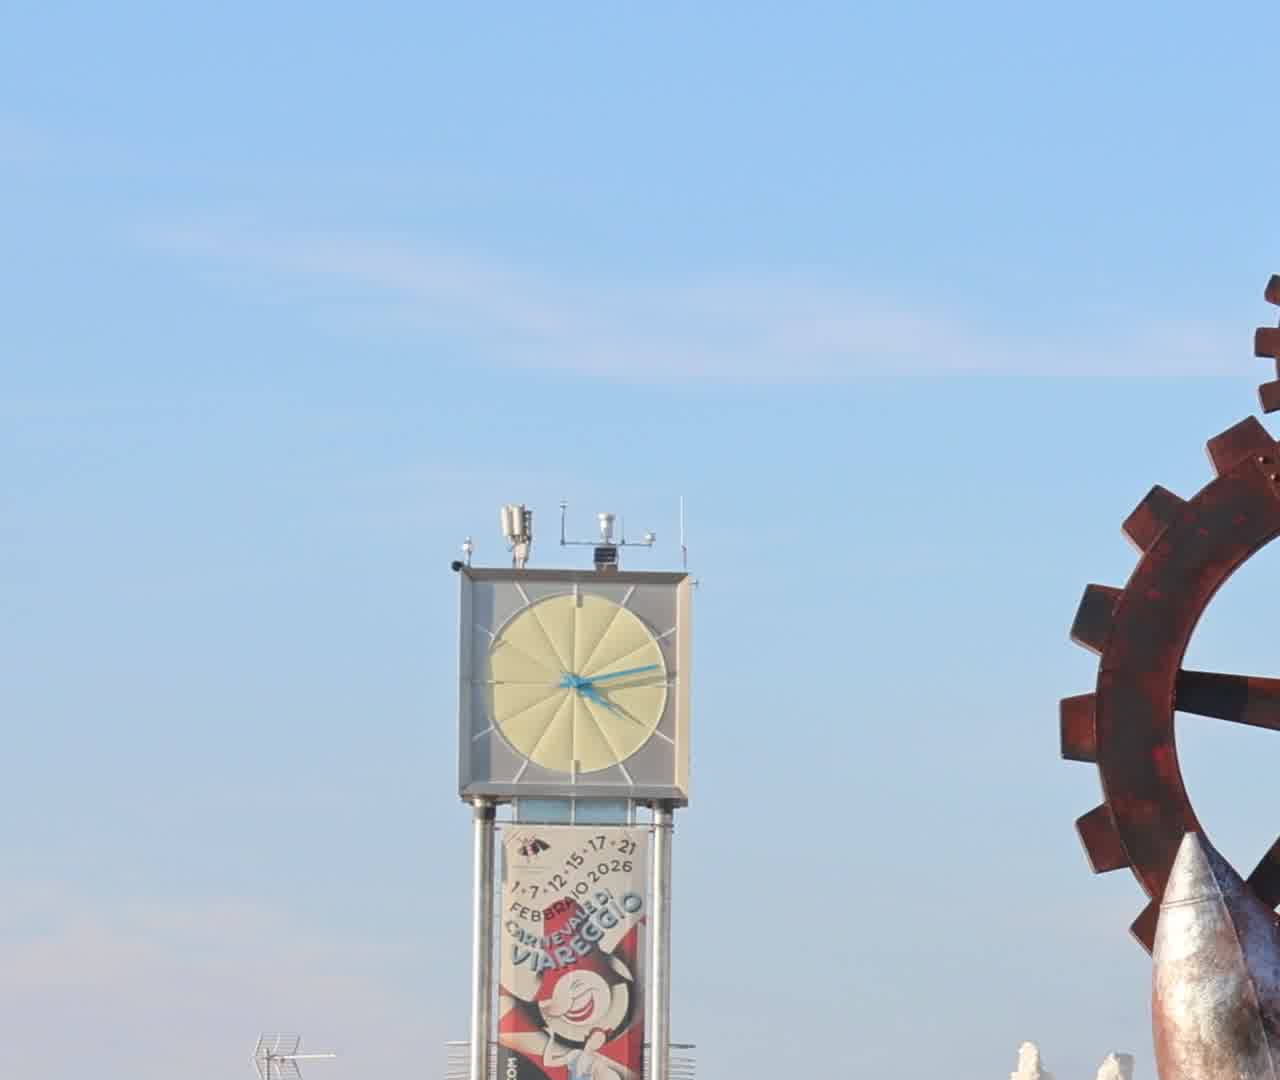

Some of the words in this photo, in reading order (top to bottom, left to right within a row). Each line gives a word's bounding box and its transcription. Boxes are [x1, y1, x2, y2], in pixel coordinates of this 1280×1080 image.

[510, 881, 589, 922] FEBBRAIO
[587, 860, 633, 883] 2026
[529, 885, 540, 899] 7
[548, 874, 567, 892] 12
[566, 852, 585, 870] 15
[588, 835, 606, 851] 17
[617, 839, 637, 855] 21
[505, 901, 597, 949] CARNEVALE
[511, 894, 642, 976] VIAREGGIO
